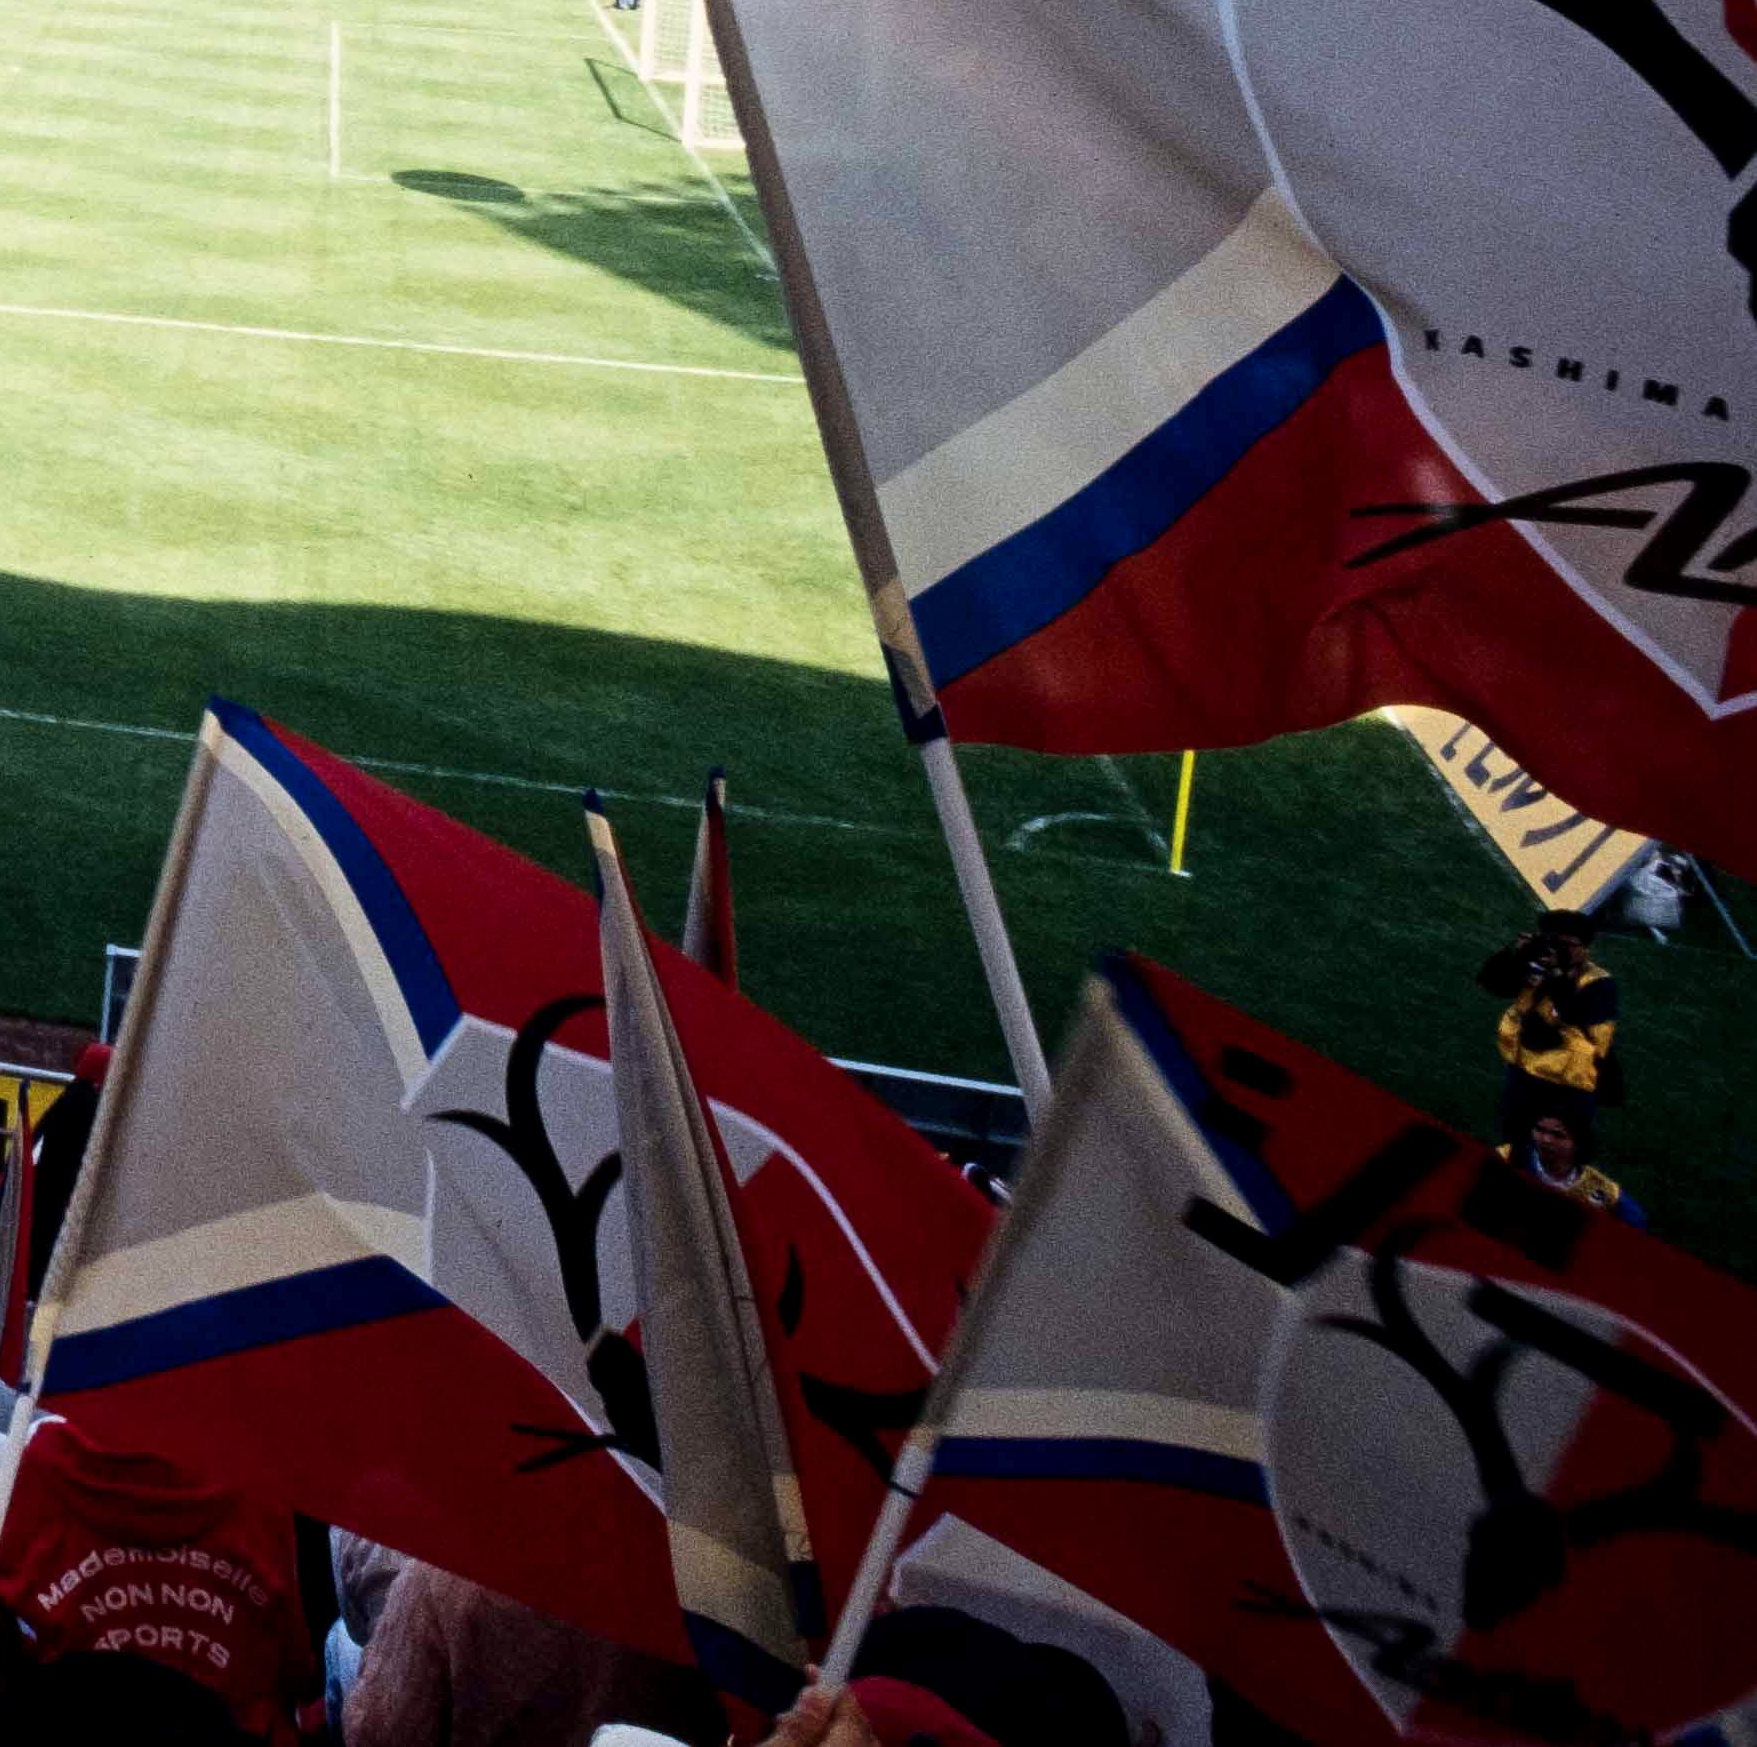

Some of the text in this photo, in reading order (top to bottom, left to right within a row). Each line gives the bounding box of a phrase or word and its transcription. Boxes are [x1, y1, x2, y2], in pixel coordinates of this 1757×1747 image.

[1423, 329, 1730, 422] KASHIMA
[37, 1544, 269, 1612] Mademoiselle
[80, 1583, 235, 1625] NON NON
